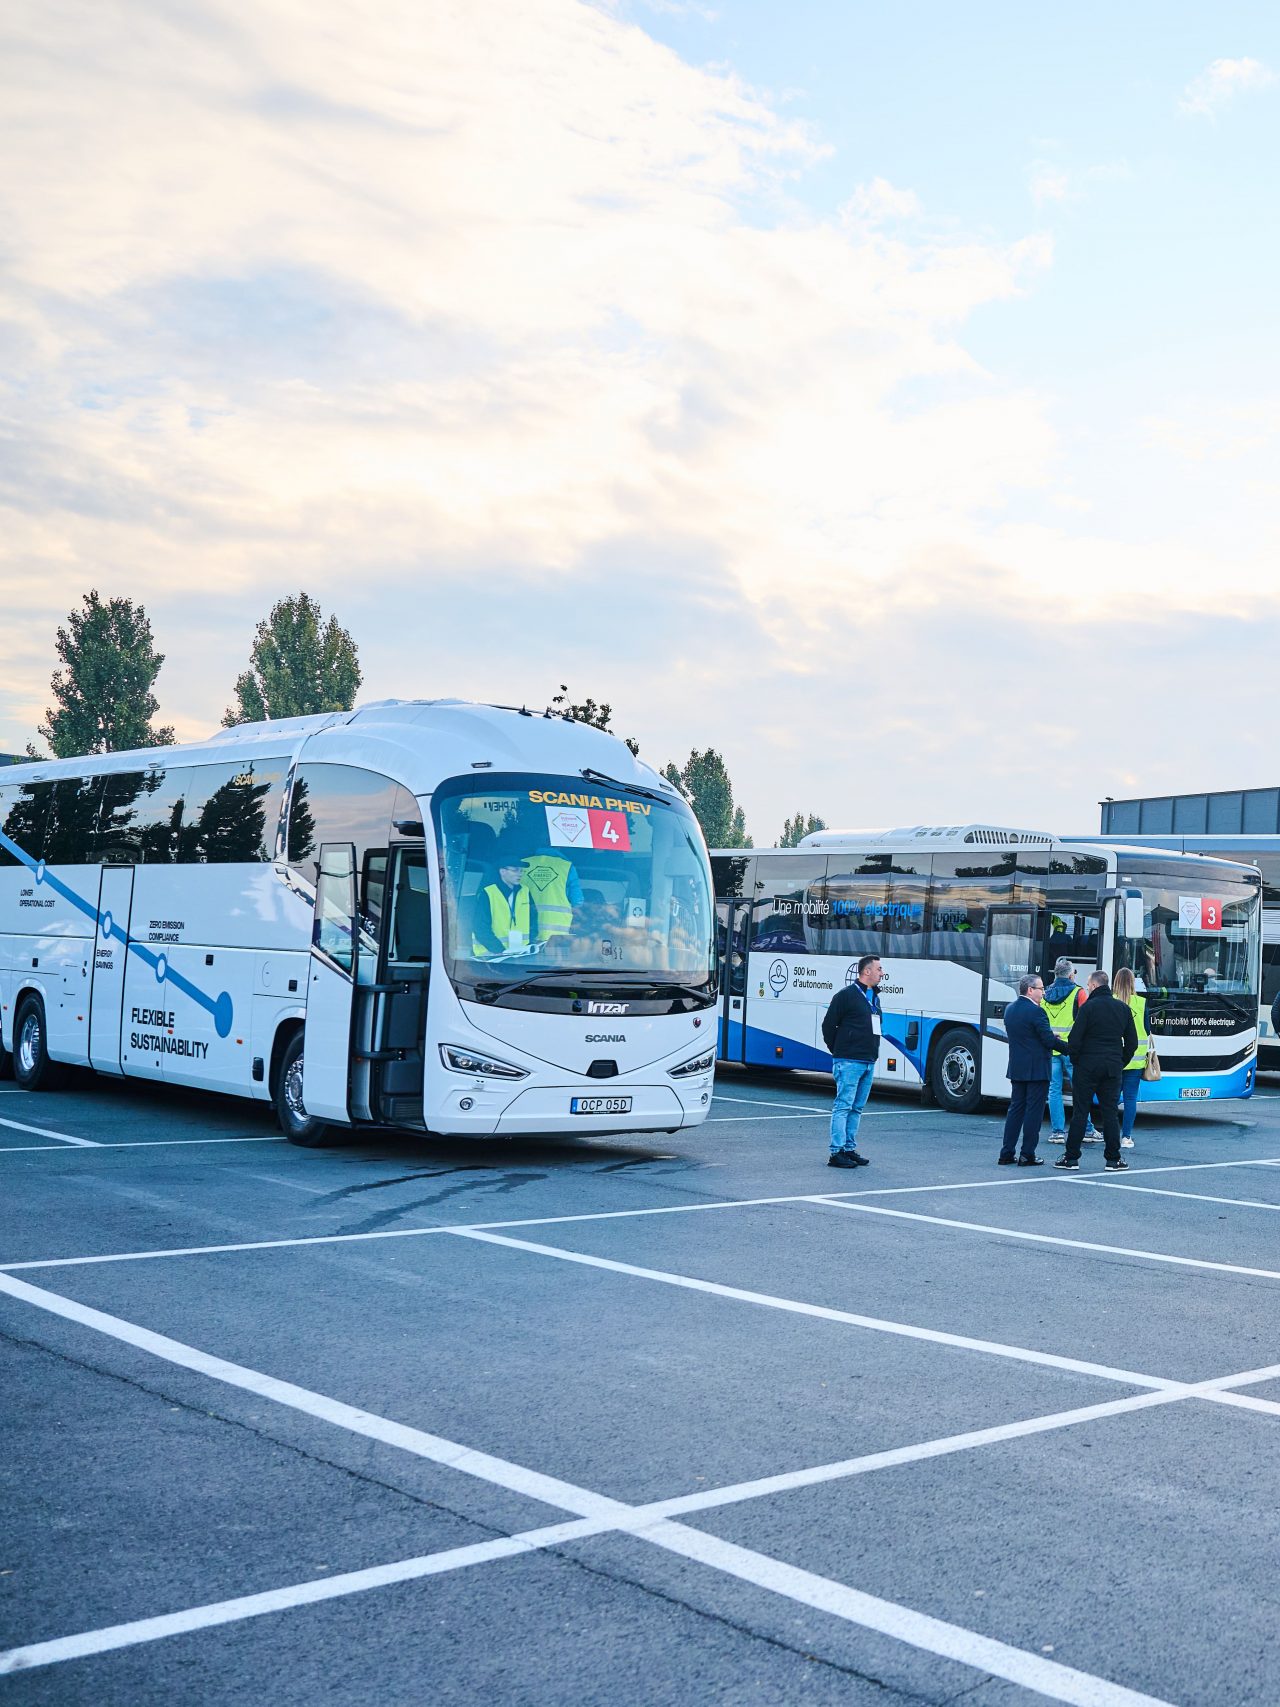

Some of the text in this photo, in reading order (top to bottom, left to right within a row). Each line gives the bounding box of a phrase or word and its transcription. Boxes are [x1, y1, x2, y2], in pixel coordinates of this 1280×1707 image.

[528, 790, 603, 809] SCANIA
[605, 797, 652, 816] PHEV
[601, 820, 620, 843] 4
[773, 899, 792, 914] Une
[794, 900, 830, 915] mobilité
[832, 901, 860, 916] 100%
[1207, 906, 1217, 925] 3
[149, 921, 185, 931] ZERO EMISSION
[148, 932, 180, 943] COMPLIANCE
[95, 960, 114, 970] SAVINGS
[793, 967, 817, 977] 500 km
[792, 979, 833, 990] d'autonomie
[587, 1000, 630, 1015] Irizar
[131, 1007, 175, 1028] FLEXIBLE
[1150, 1016, 1236, 1027] Une mobilité 100% électrique
[584, 1034, 626, 1043] SCANIA
[130, 1032, 209, 1060] SUSTAINABILITY
